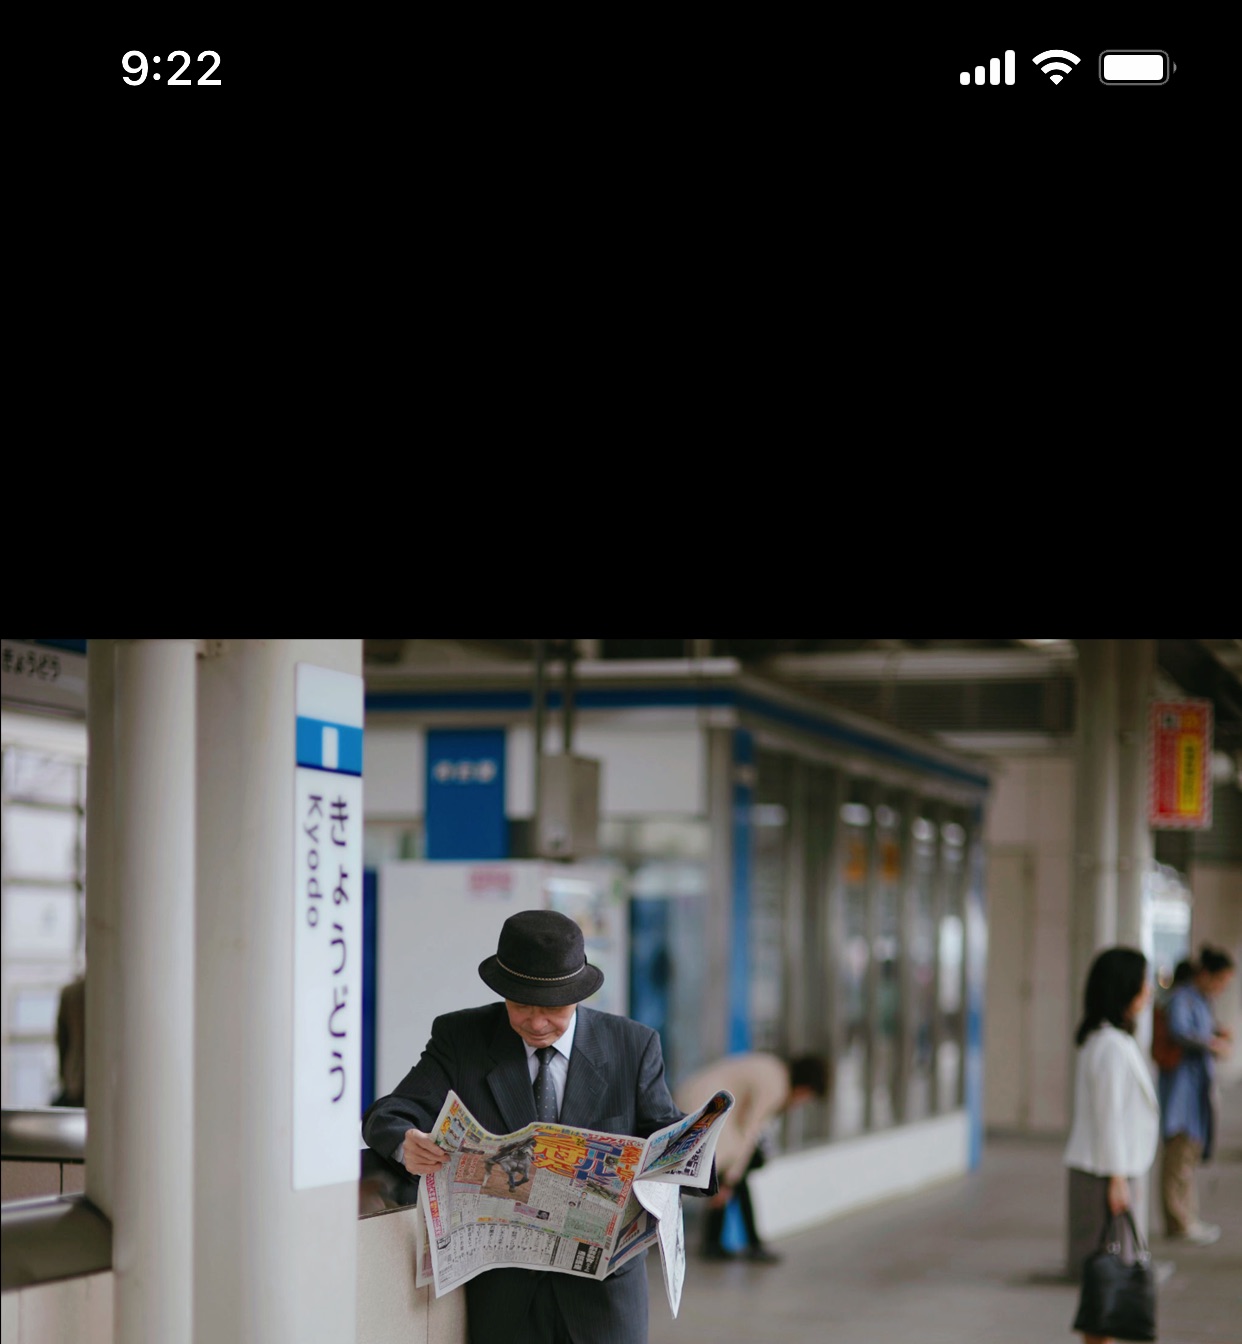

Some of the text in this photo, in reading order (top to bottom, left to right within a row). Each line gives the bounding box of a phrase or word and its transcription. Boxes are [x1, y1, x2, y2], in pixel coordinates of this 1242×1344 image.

[121, 50, 223, 88] 9:22
[303, 794, 323, 928] Kyodo
[328, 795, 349, 1103] きょうどう
